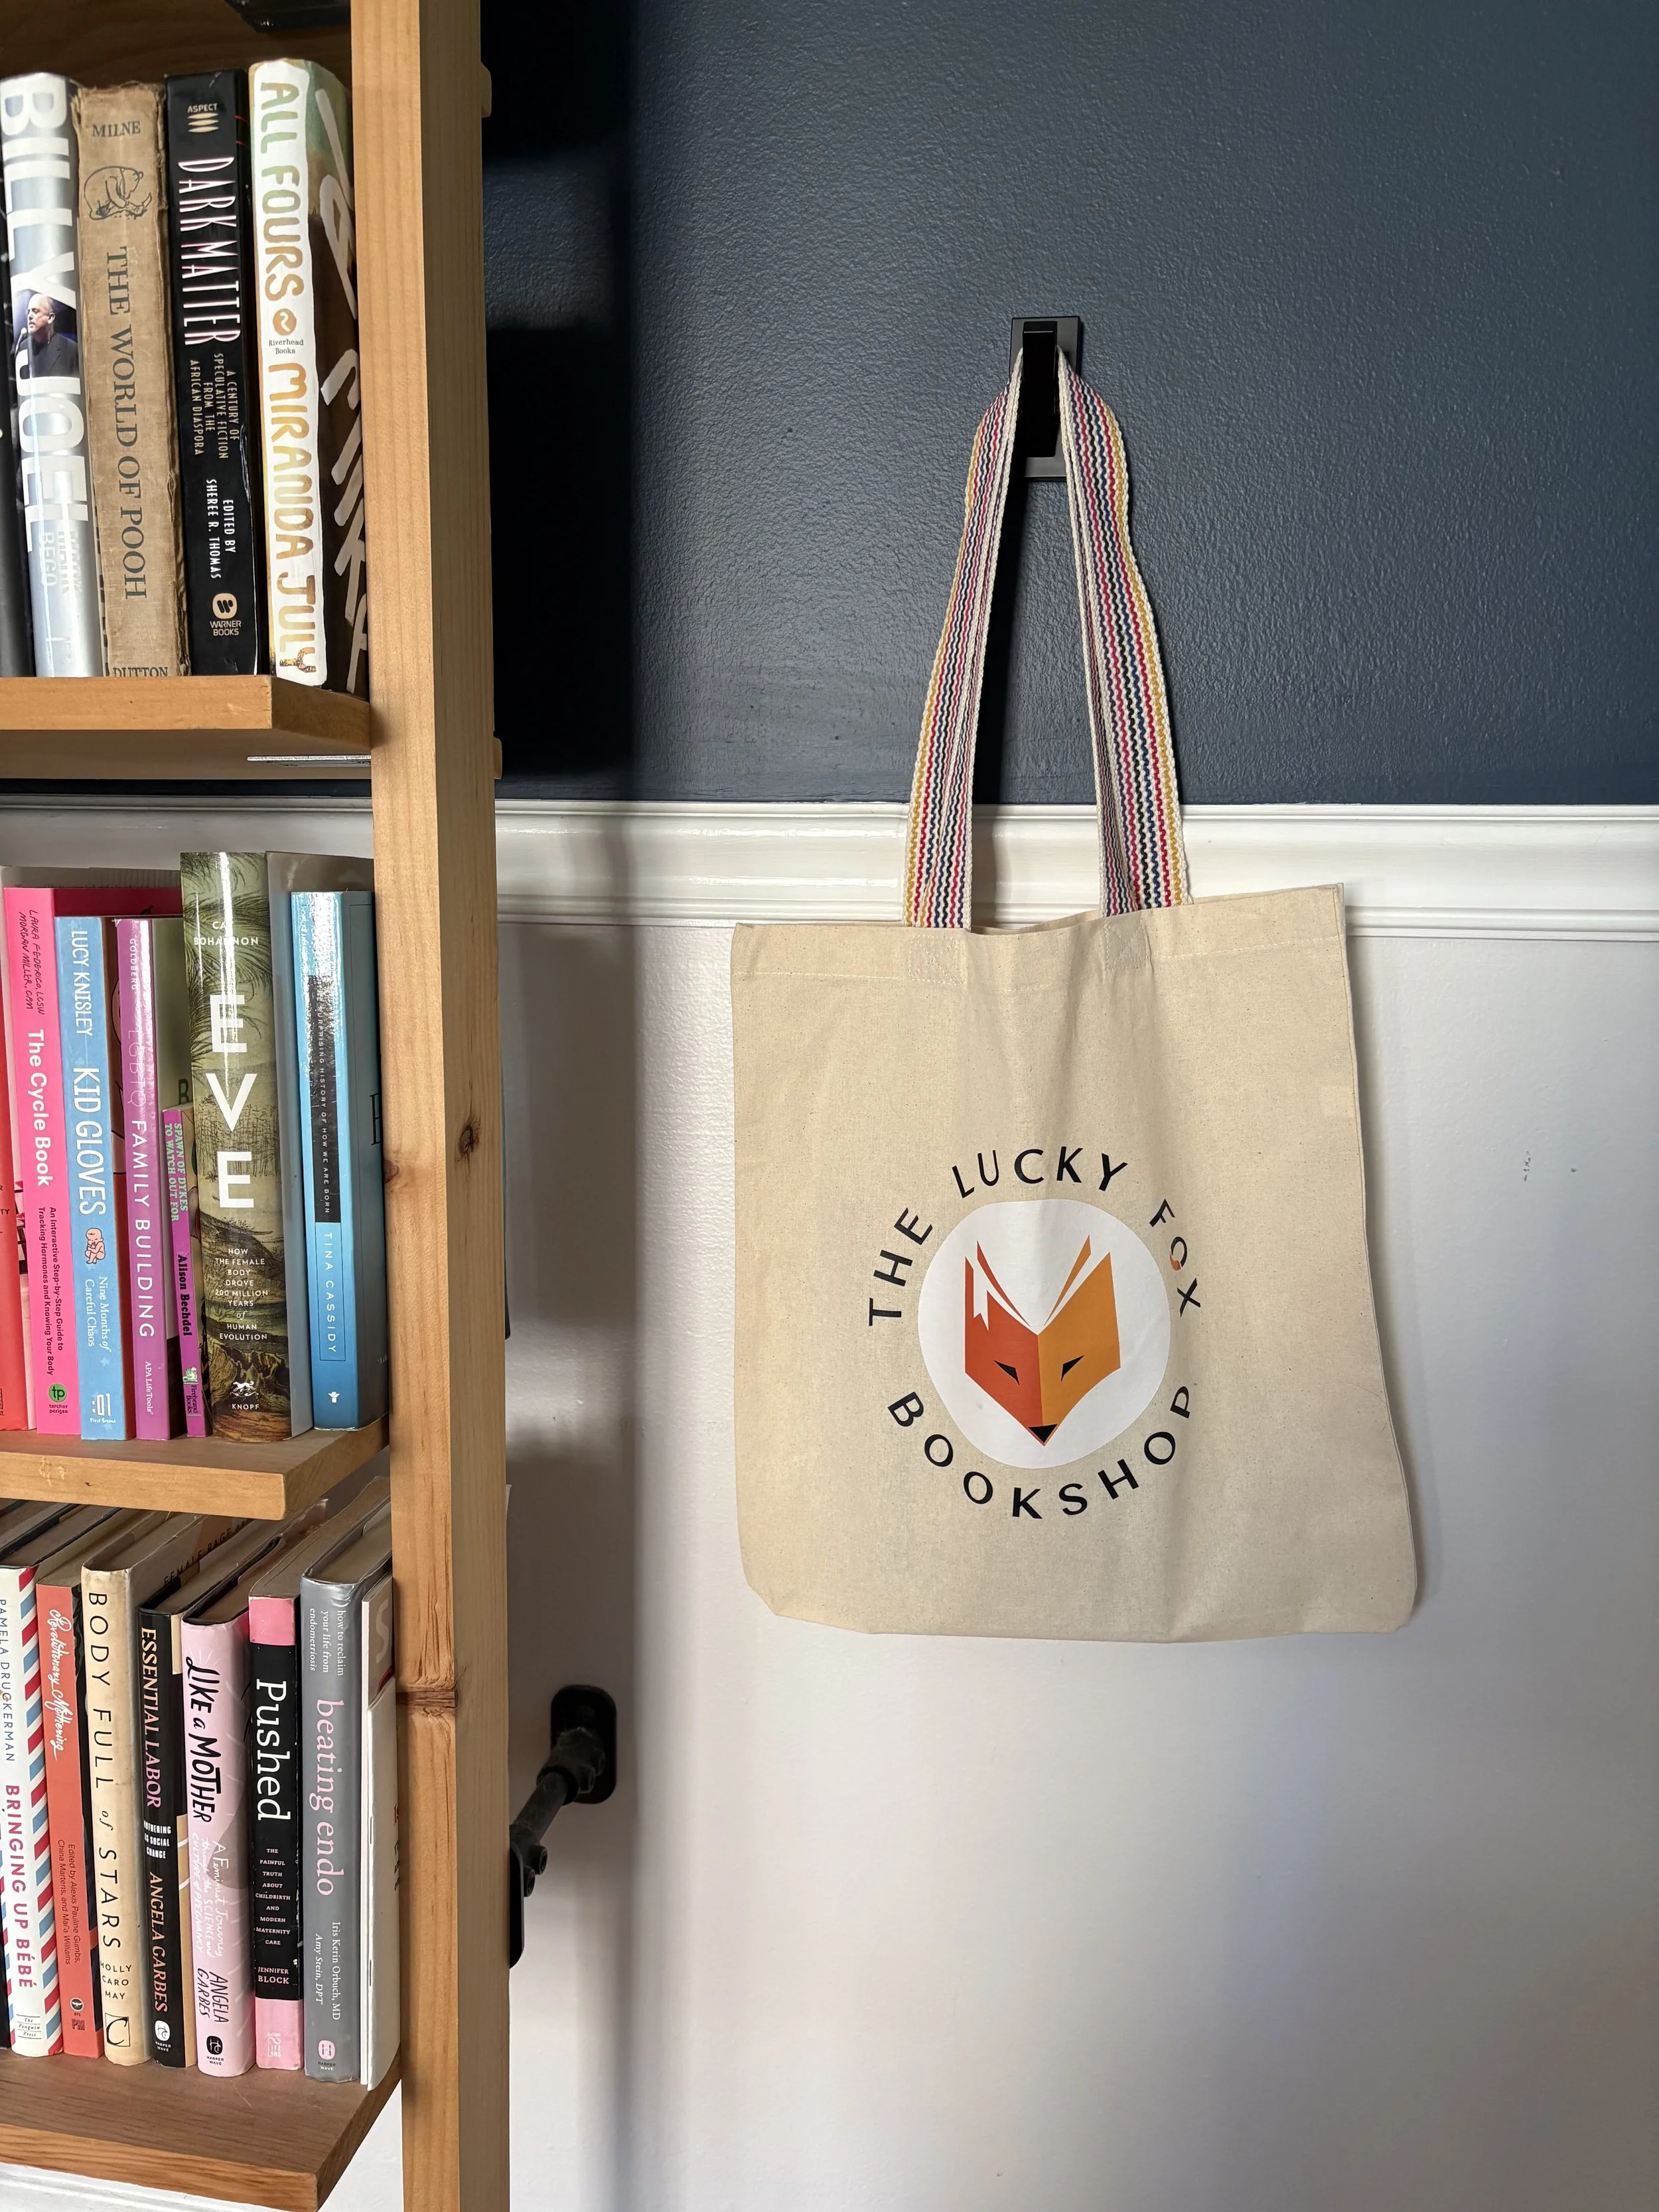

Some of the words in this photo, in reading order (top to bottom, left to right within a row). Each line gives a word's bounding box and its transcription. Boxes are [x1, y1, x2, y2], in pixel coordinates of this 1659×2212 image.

[91, 120, 141, 137] MILNE
[188, 103, 218, 113] ASPECT
[259, 82, 299, 154] ALL
[1, 79, 76, 309] BILLY
[179, 157, 236, 231] DARK
[261, 165, 305, 301] FOURS
[107, 246, 130, 315] THE
[180, 240, 240, 345] MATTER
[269, 338, 304, 347] Riverhead
[110, 325, 138, 447] WORLD
[190, 360, 202, 402] AFRICAN
[203, 382, 214, 408] FROM
[214, 353, 226, 417] SPECULATIVE
[205, 415, 215, 431] THE
[227, 382, 238, 424] CENTURY
[16, 349, 88, 552] JOEL
[192, 407, 204, 455] DIASPORA
[217, 422, 228, 459] FICTION
[230, 429, 240, 440] OF
[117, 455, 142, 498] OF
[267, 362, 314, 559] MIRANDA
[206, 479, 219, 516] SHEREE
[223, 500, 235, 535] EDITED
[208, 522, 219, 532] R.
[225, 540, 236, 552] BY
[121, 507, 147, 599] POOH
[209, 537, 222, 579] THOMAS
[277, 571, 317, 673] JULY
[71, 931, 89, 966] LUCY
[73, 972, 92, 1037] KNISLEY
[28, 1029, 44, 1067] The
[28, 1072, 49, 1131] Cycle
[73, 1068, 101, 1113] KID
[206, 995, 257, 1208] EVE
[165, 1124, 173, 1136] TO
[321, 1112, 326, 1123] OF
[166, 1140, 176, 1175] WATCH
[174, 1123, 184, 1157] SPAWN
[323, 1151, 328, 1163] WE
[35, 1137, 53, 1187] Book
[75, 1120, 106, 1215] GLOVES
[131, 1120, 149, 1207] FAMILY
[177, 1161, 185, 1174] OF
[169, 1178, 177, 1199] OUT
[178, 1177, 188, 1211] DYKES
[869, 1207, 933, 1327] THE
[952, 1146, 1127, 1199] LUCKY
[1149, 1199, 1201, 1317] FOX
[50, 1207, 56, 1218] An
[53, 1264, 62, 1317] Step-by-Step
[58, 1341, 63, 1351] to
[99, 1276, 108, 1299] Nine
[135, 1220, 155, 1337] BUILDING
[177, 1254, 188, 1290] Alison
[85, 1279, 96, 1315] Careful
[180, 1293, 192, 1337] Bechdel
[236, 1311, 246, 1320] of
[326, 1280, 336, 1353] CASSIDY
[87, 1317, 97, 1347] Chaos
[100, 1301, 110, 1339] Months
[100, 1341, 111, 1352] of
[887, 1386, 1190, 1520] BOOKSHOP
[0, 1599, 9, 1655] PAMELA
[89, 1593, 110, 1686] BODY
[336, 1610, 346, 1630] how
[338, 1631, 343, 1641] to
[47, 1609, 72, 1689] Revolutionary
[323, 1652, 331, 1673] from
[337, 1643, 346, 1676] reclaim
[141, 1627, 159, 1735] ESSENTIAL
[186, 1657, 220, 1714] LIKE
[1, 1662, 15, 1761] DRUCKERMAN
[44, 1690, 73, 1761] Mothering
[93, 1708, 113, 1788] FULL
[255, 1678, 291, 1821] Pushed
[309, 1699, 344, 1813] beating
[145, 1741, 161, 1808] LABOR
[188, 1733, 221, 1823] MOTHER
[6, 1785, 26, 1893] BRINGING
[100, 1810, 113, 1830] of
[150, 1836, 170, 1846] SOCIAL
[147, 1846, 166, 1858] CHANGE
[213, 1841, 226, 1854] A
[317, 1822, 344, 1895] endo
[69, 1870, 77, 1881] by
[14, 1903, 28, 1929] UP
[100, 1848, 121, 1948] STARS
[149, 1872, 165, 1941] ANGELA
[204, 1899, 213, 1941] SCIENCE
[215, 1909, 228, 1957] Journey
[16, 1938, 37, 1988] BÉBÉ
[314, 1933, 323, 1951] Amy
[100, 1961, 131, 1972] MOLLY
[102, 1976, 129, 1986] CARO
[153, 1946, 167, 2012] GARBES
[257, 1966, 289, 1975] JENNIFER
[258, 1976, 289, 1984] BLOCK
[332, 1966, 341, 2000] Orbuch,
[105, 1990, 125, 1999] MAY
[198, 1968, 210, 2018] GARBES
[208, 1971, 228, 2023] ANGELA
[332, 2002, 340, 2020] MD
